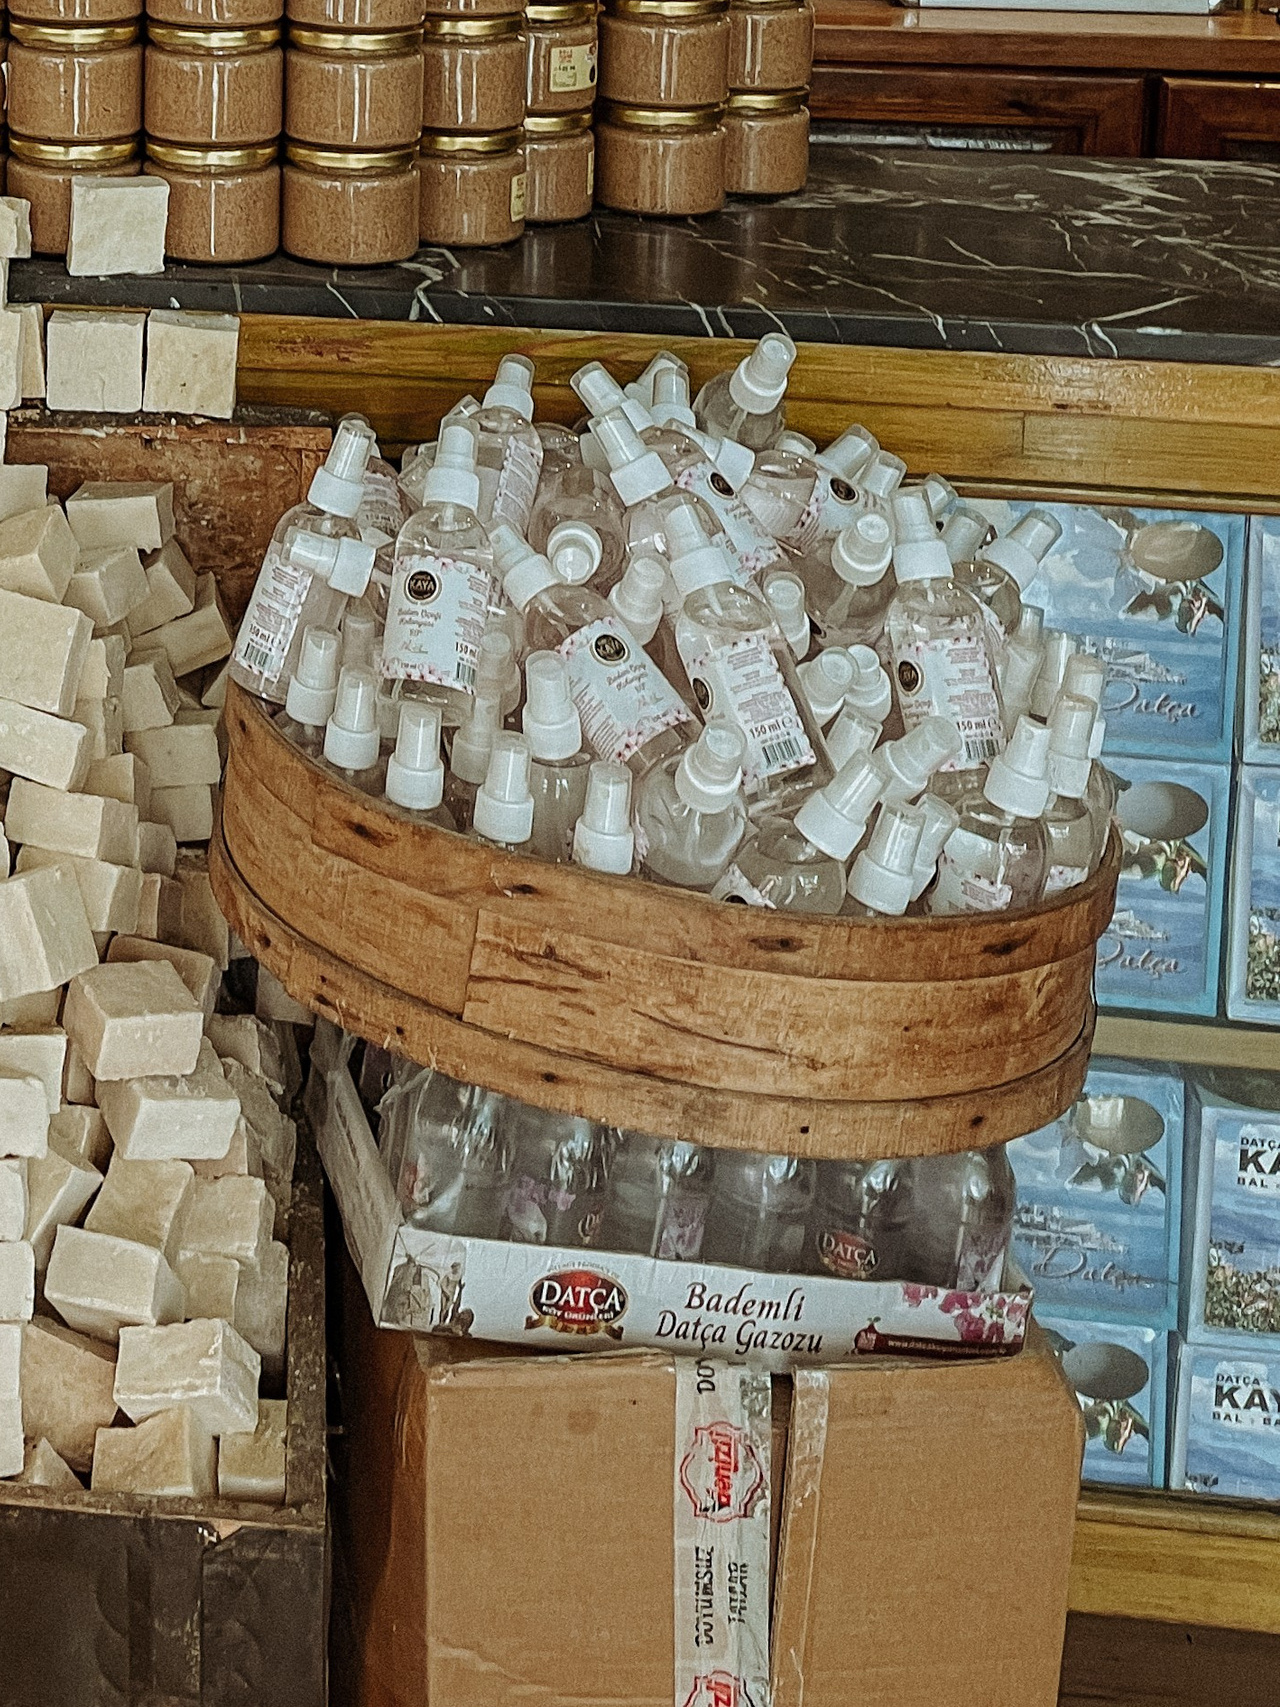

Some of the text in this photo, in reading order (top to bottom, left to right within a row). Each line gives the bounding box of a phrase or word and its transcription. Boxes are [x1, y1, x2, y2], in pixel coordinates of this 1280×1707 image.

[750, 723, 767, 739] 150
[822, 1233, 876, 1270] DATÇA
[540, 1279, 621, 1315] DATÇA
[685, 1282, 805, 1321] Bademli
[655, 1310, 823, 1355] Datça Gazozu
